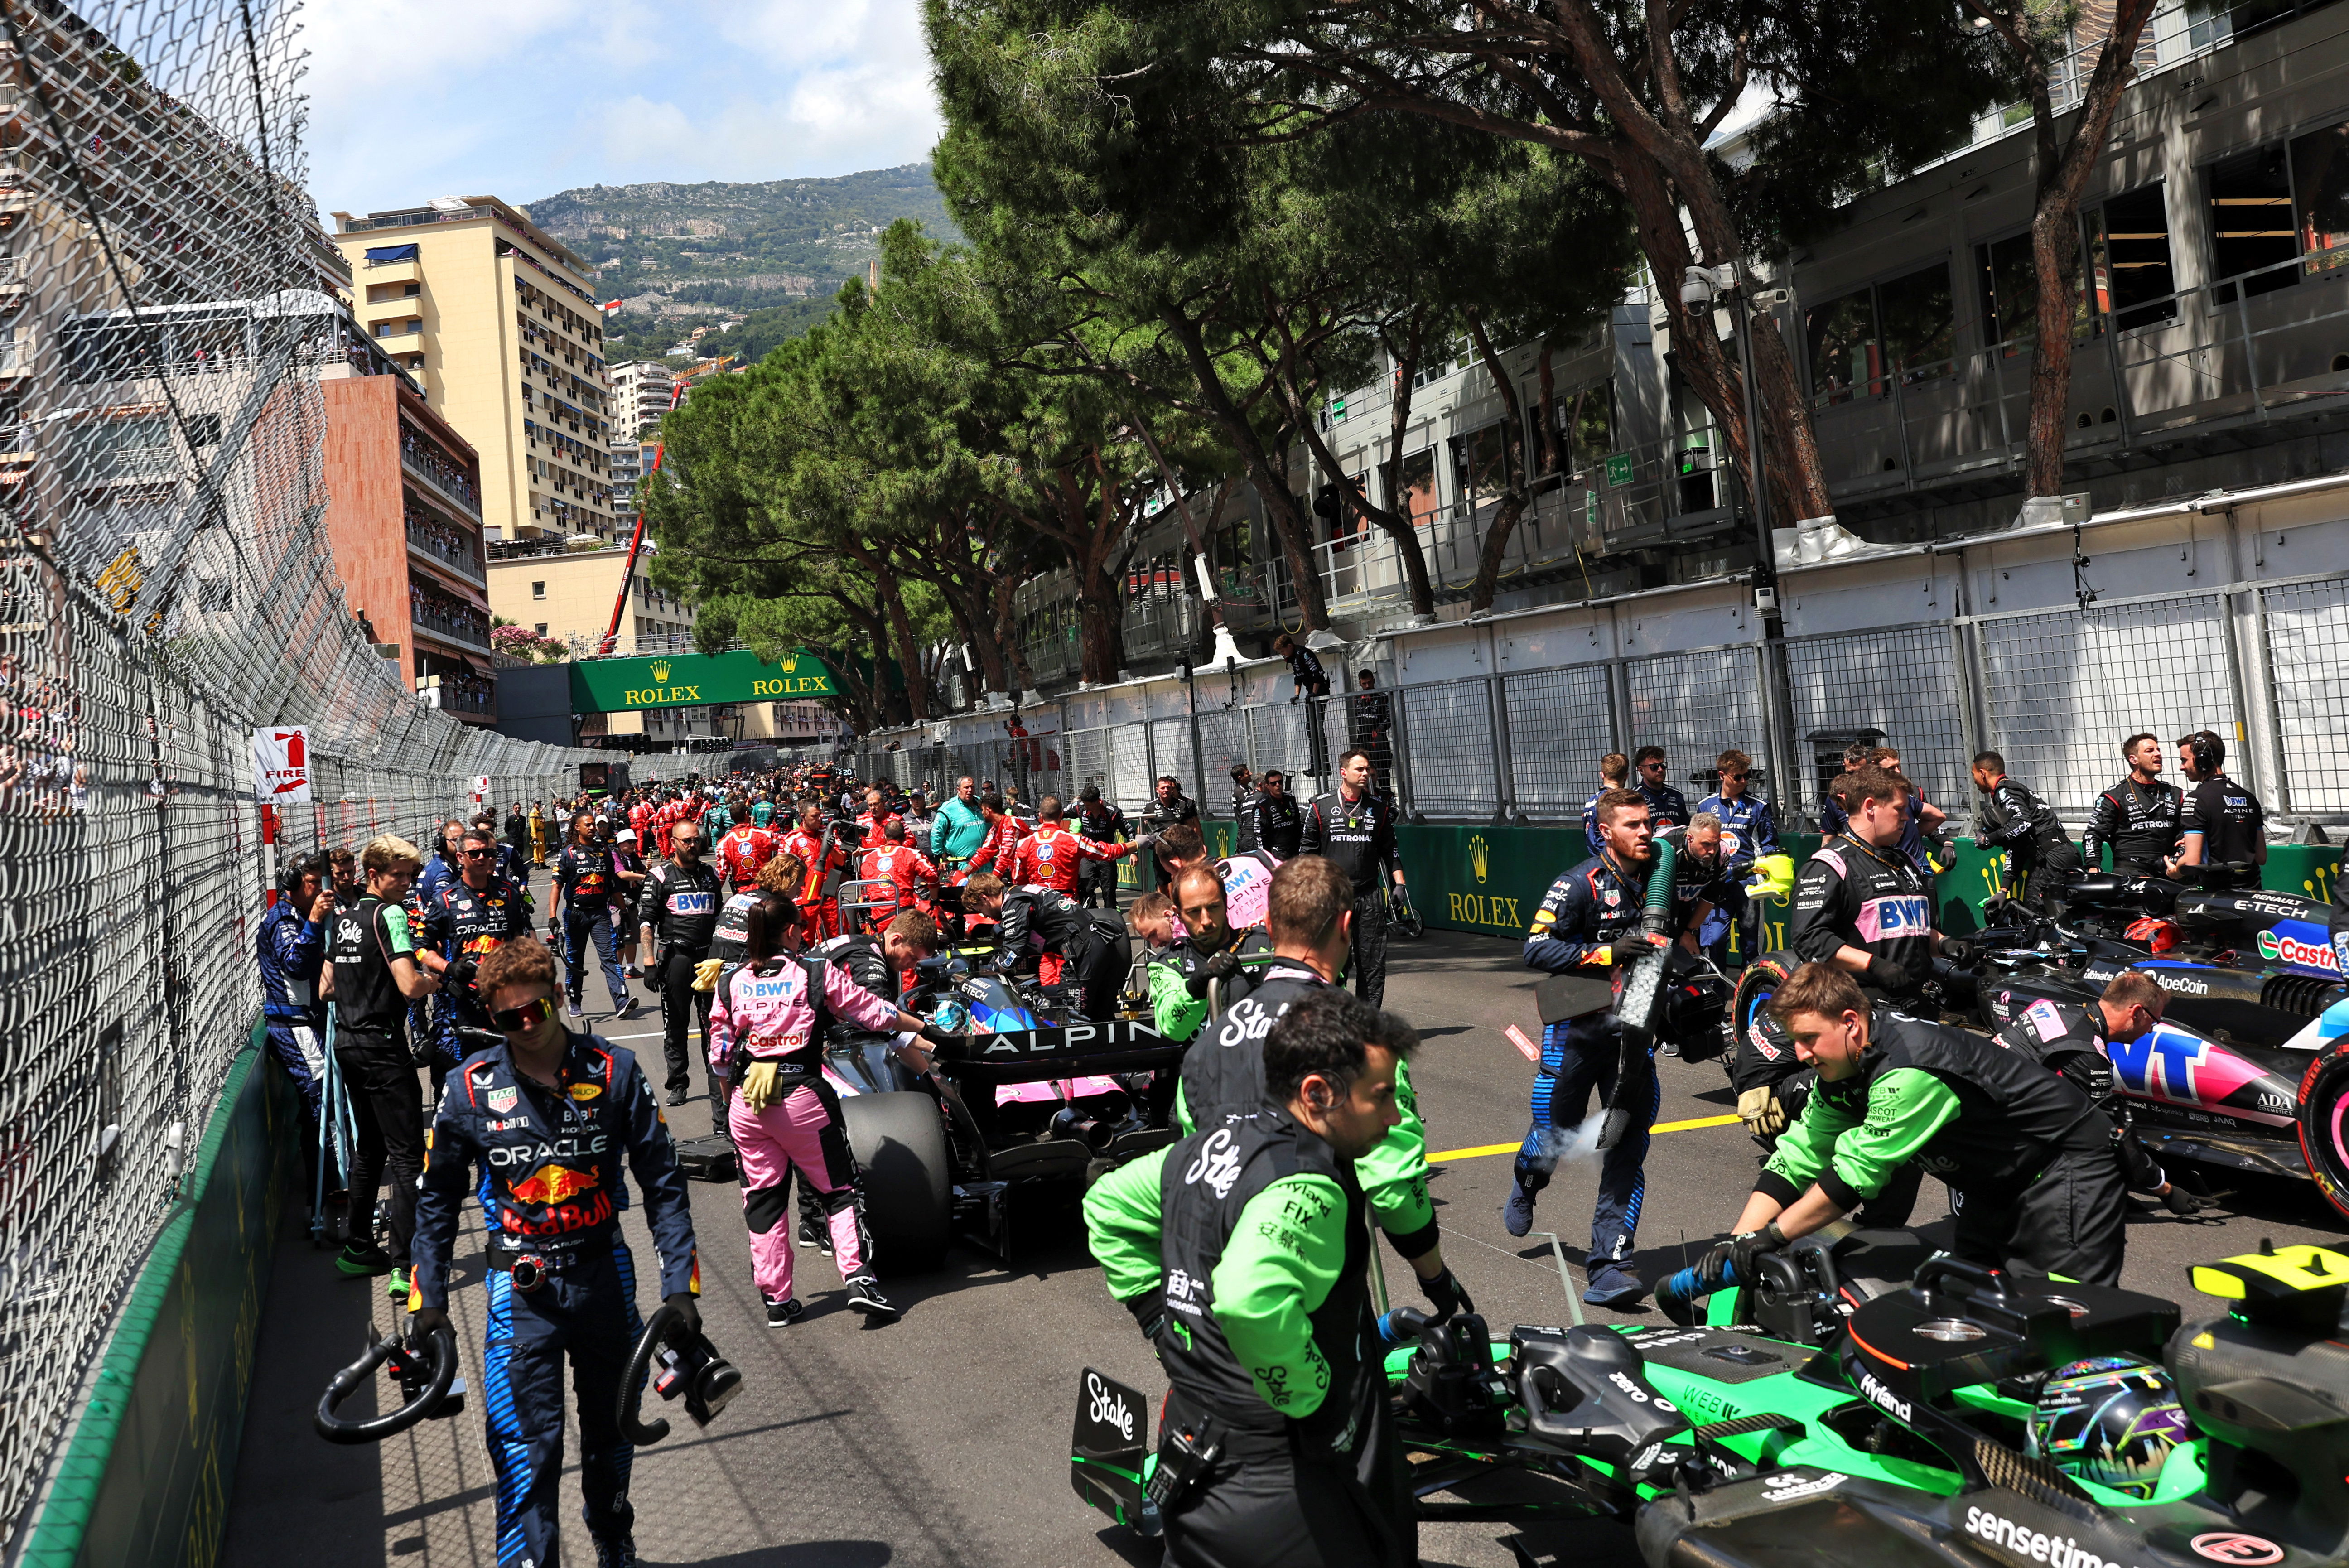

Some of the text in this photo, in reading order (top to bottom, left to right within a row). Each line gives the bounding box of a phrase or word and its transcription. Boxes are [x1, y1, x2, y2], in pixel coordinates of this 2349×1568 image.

[752, 676, 828, 695] ROLEX
[625, 685, 701, 704] ROLEX
[266, 770, 305, 778] FIRE
[2231, 797, 2247, 806] BWT
[1040, 845, 1052, 860] hp
[1226, 868, 1253, 893] BWT
[1228, 878, 1270, 910] LPINE
[1246, 894, 1264, 907] TEAM
[2252, 893, 2303, 906] RENAULT
[677, 894, 714, 911] BWT
[738, 899, 752, 907] BW
[1449, 893, 1523, 928] ROLEX
[2234, 900, 2309, 918] E-TECH
[722, 907, 748, 917] ALPIN
[1879, 900, 1929, 929] BWT
[456, 922, 508, 934] ORACLE
[2281, 940, 2340, 970] Castr
[970, 978, 991, 989] RENAULT
[2084, 970, 2114, 981] ultimate
[757, 981, 792, 996] BWT
[961, 983, 988, 1001] E-TECH
[2158, 974, 2208, 995] ApeCoin
[732, 999, 803, 1014] ALPINE
[1171, 1004, 1190, 1022] Stak
[1992, 1003, 2009, 1012] CHANGE
[972, 1018, 994, 1034] Castro
[1220, 998, 1289, 1047] Sta
[748, 1030, 805, 1047] Castrol
[984, 1020, 1161, 1054] ALPIN
[1750, 1026, 1778, 1059] Castrol
[777, 1064, 804, 1072] stars
[2108, 1031, 2204, 1105] WT
[490, 1089, 514, 1100] TAG
[2257, 1092, 2292, 1110] ADA
[490, 1097, 517, 1109] HEUER
[2127, 1100, 2147, 1110] ahoo!
[2258, 1106, 2293, 1116] COSMETICS
[564, 1107, 599, 1122] BBIT
[1868, 1108, 1897, 1116] ASCOT
[2196, 1114, 2209, 1123] BRB
[486, 1118, 516, 1132] Mobil
[561, 1124, 601, 1133] HODA
[488, 1135, 608, 1166] ORACLE
[502, 1190, 612, 1235] Red Bull
[1283, 1200, 1314, 1228] FIX
[1683, 1384, 1722, 1414] WEB
[1860, 1373, 1912, 1423] Hyland
[1087, 1372, 1133, 1441] Stake
